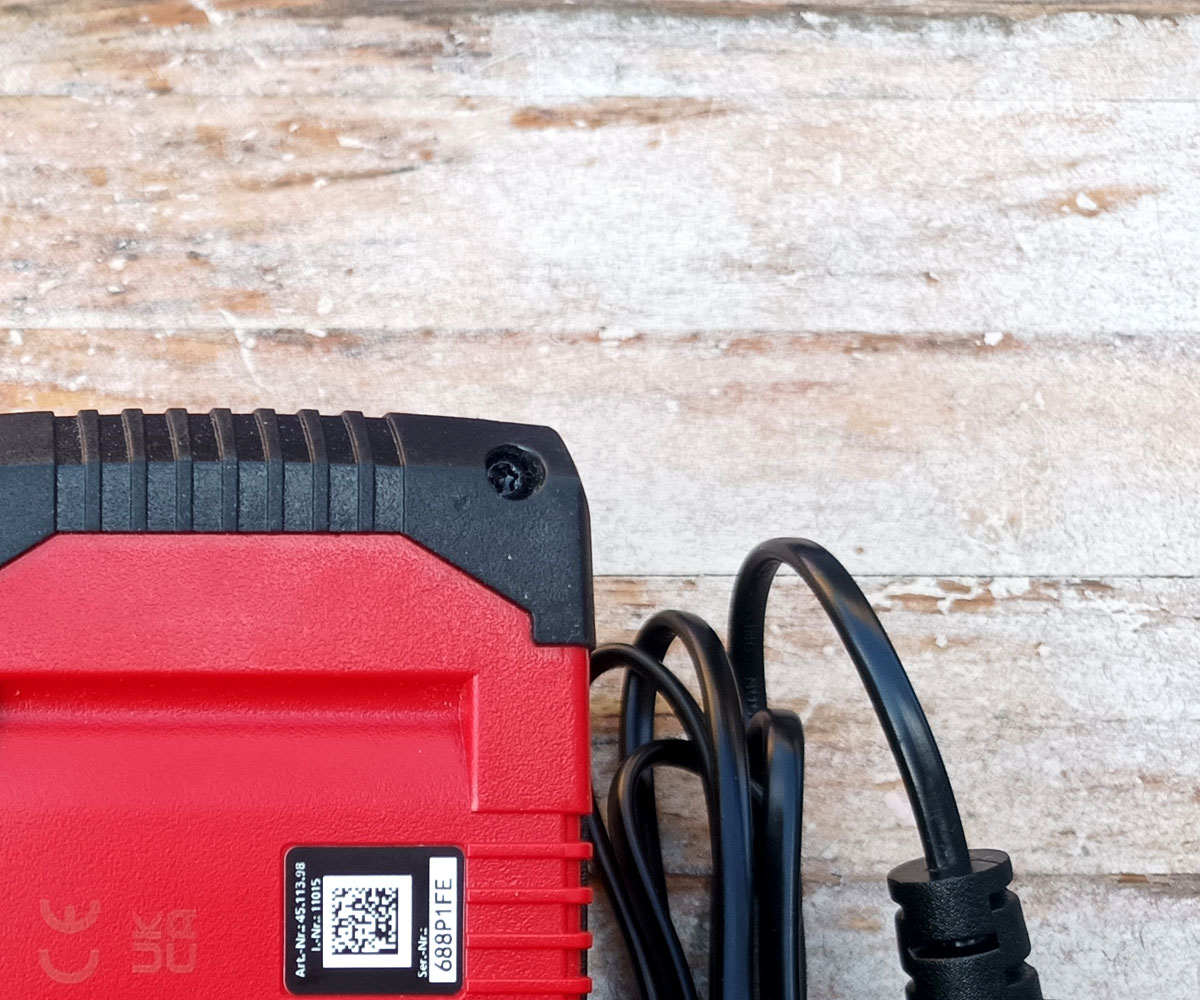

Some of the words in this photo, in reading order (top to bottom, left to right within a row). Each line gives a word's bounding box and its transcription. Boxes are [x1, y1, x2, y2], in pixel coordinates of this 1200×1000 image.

[295, 862, 306, 922] 45.113.98
[311, 878, 321, 912] 11015
[295, 925, 306, 977] Art.-Nr.:
[434, 879, 452, 972] 688P1FE
[418, 928, 428, 978] Ser.-Nr.:
